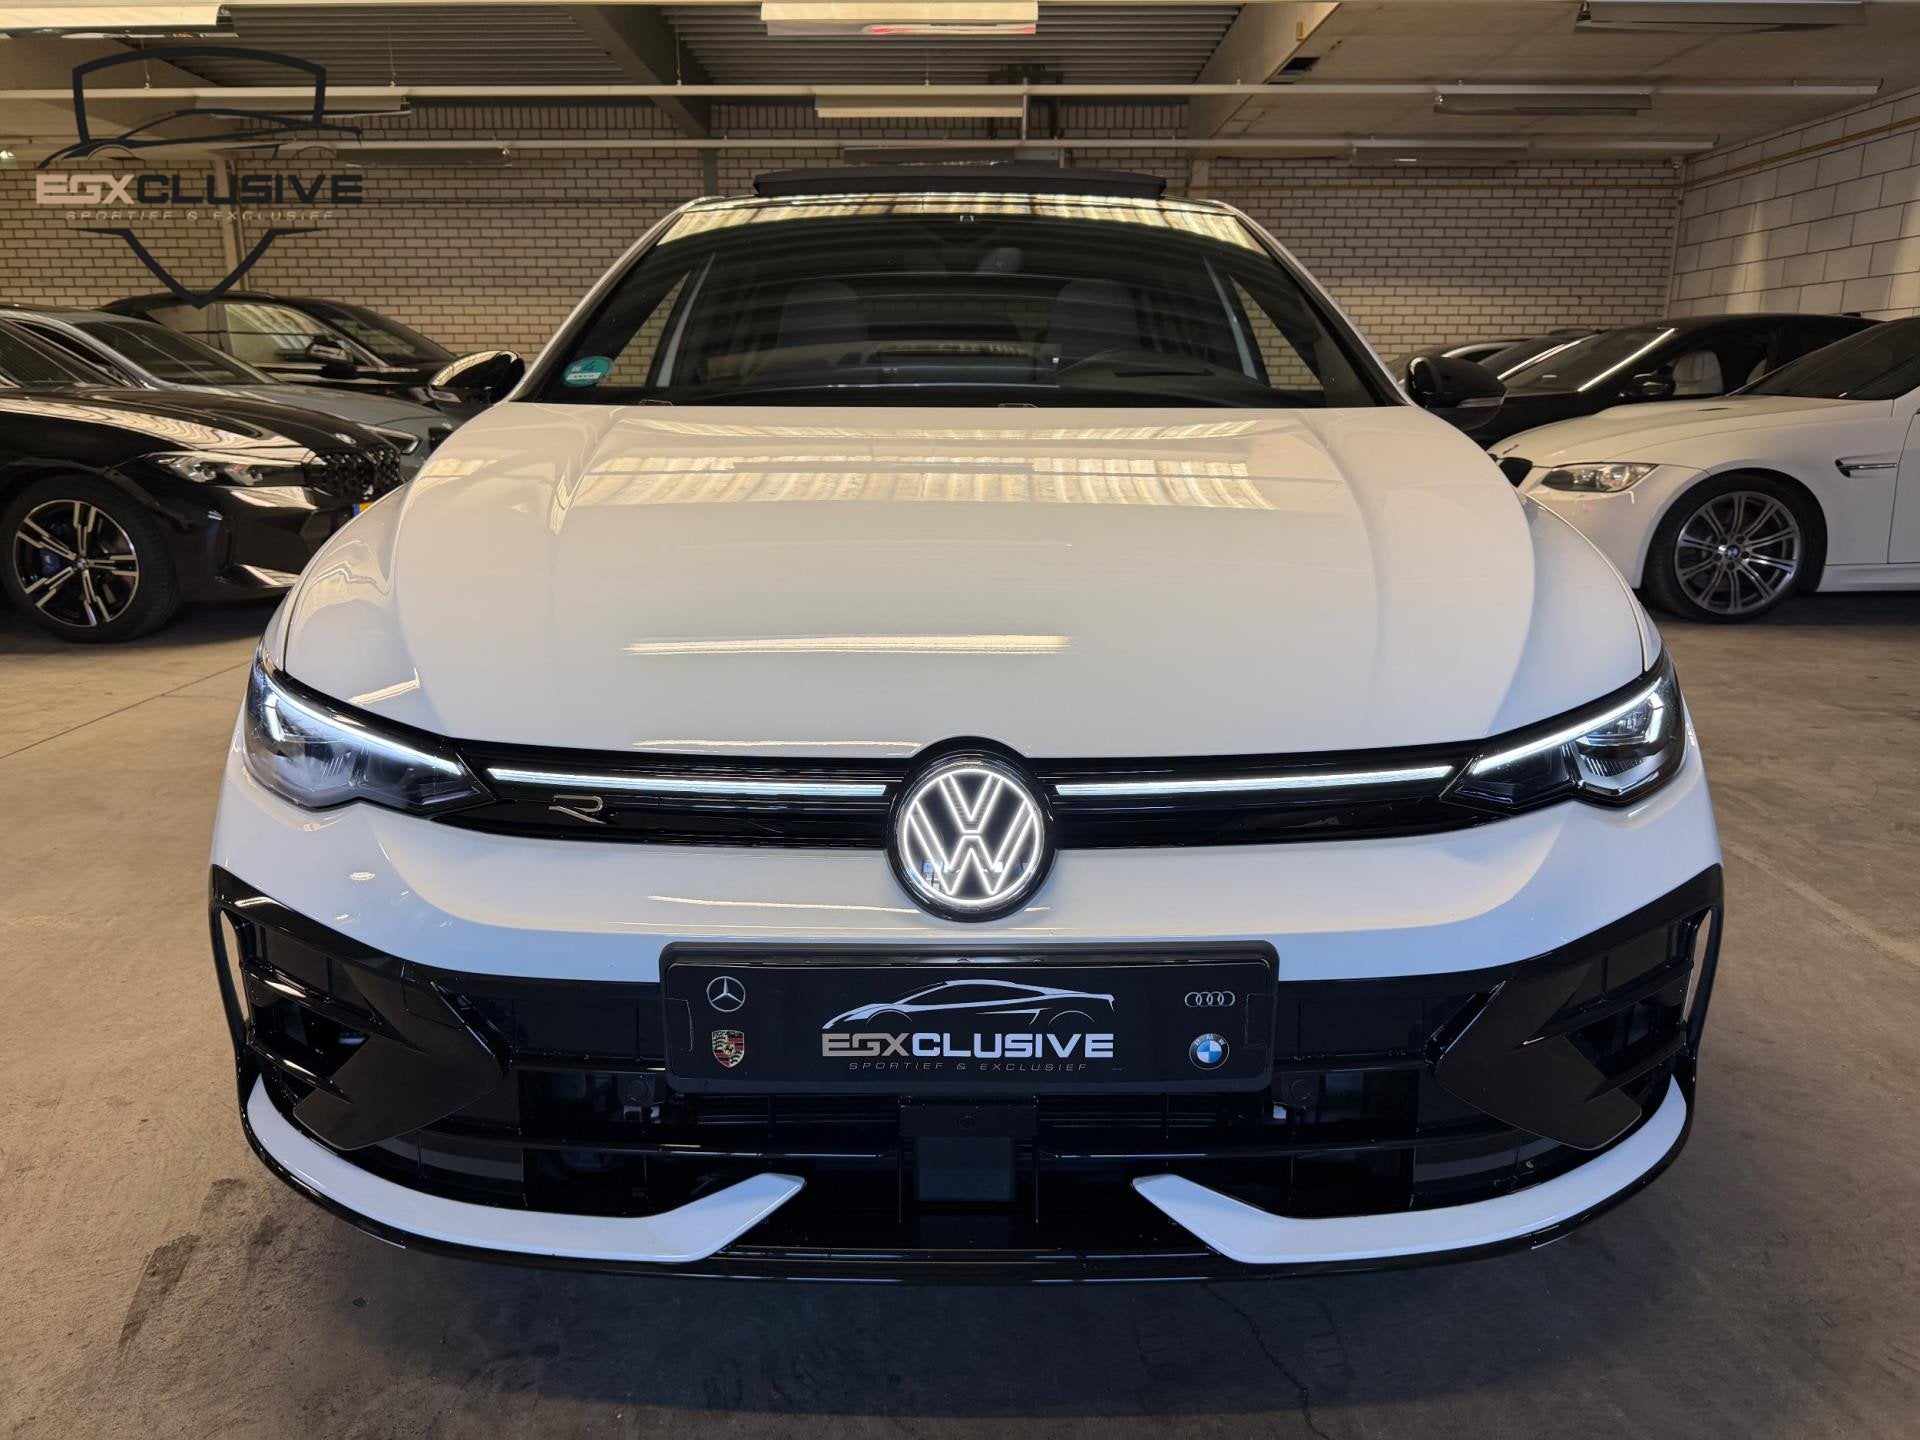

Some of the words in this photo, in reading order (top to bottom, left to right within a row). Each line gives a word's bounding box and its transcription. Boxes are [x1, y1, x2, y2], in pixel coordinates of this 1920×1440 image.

[822, 1032, 1114, 1058] EGXCLUSIVE
[849, 1062, 943, 1070] SPORTIEF
[956, 1062, 967, 1070] &
[980, 1063, 1088, 1071] EXCLUSIEF
